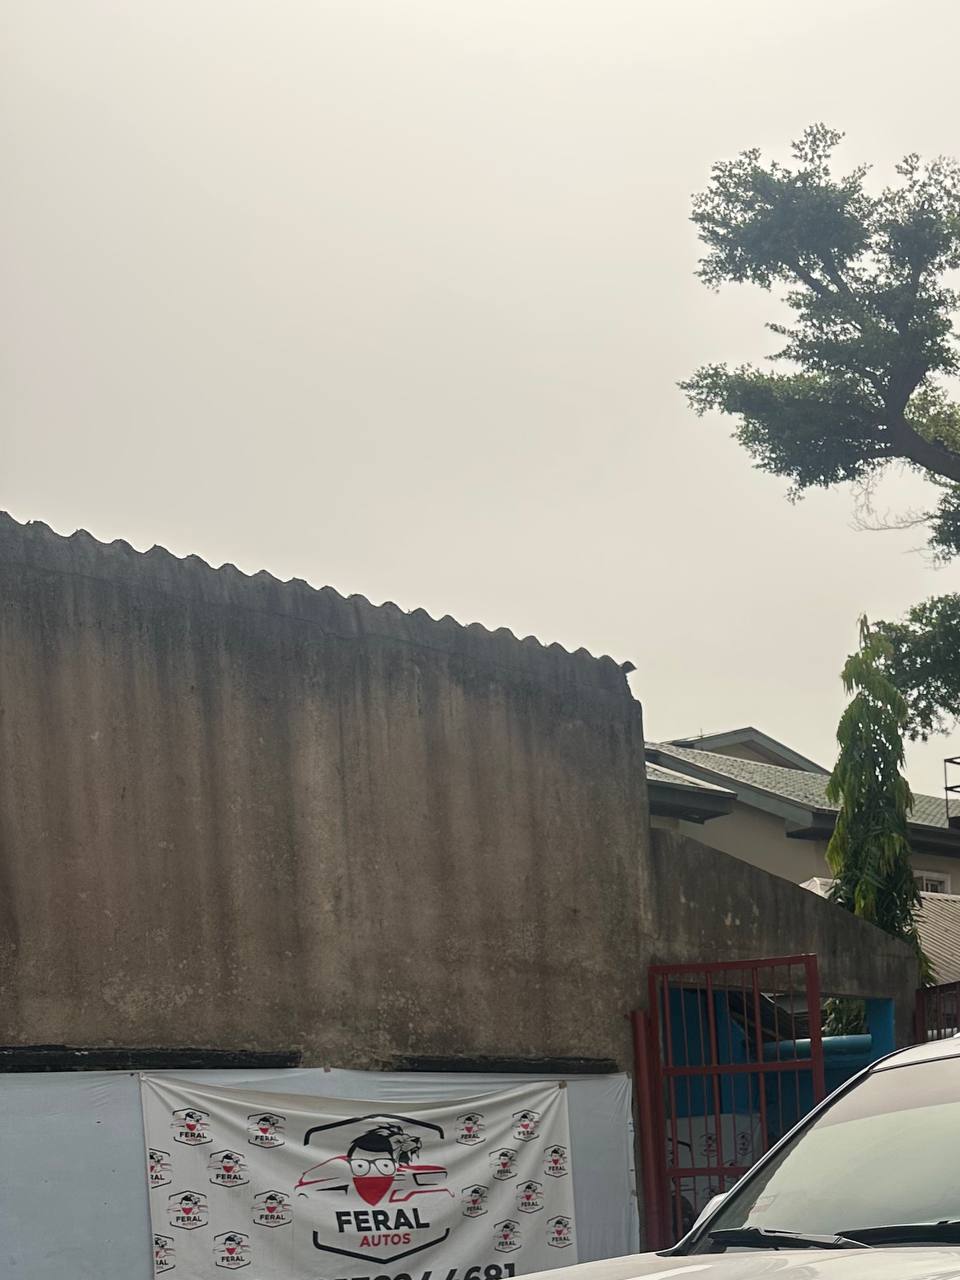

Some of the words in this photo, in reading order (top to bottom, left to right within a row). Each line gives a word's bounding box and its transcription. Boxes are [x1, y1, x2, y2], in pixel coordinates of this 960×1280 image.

[179, 1131, 208, 1139] FERAL
[215, 1173, 243, 1181] FERAL
[175, 1215, 203, 1223] FERAL
[259, 1213, 286, 1221] FERAL
[335, 1207, 431, 1233] FERAL
[359, 1232, 412, 1248] AUTOS
[221, 1255, 246, 1263] FERAL
